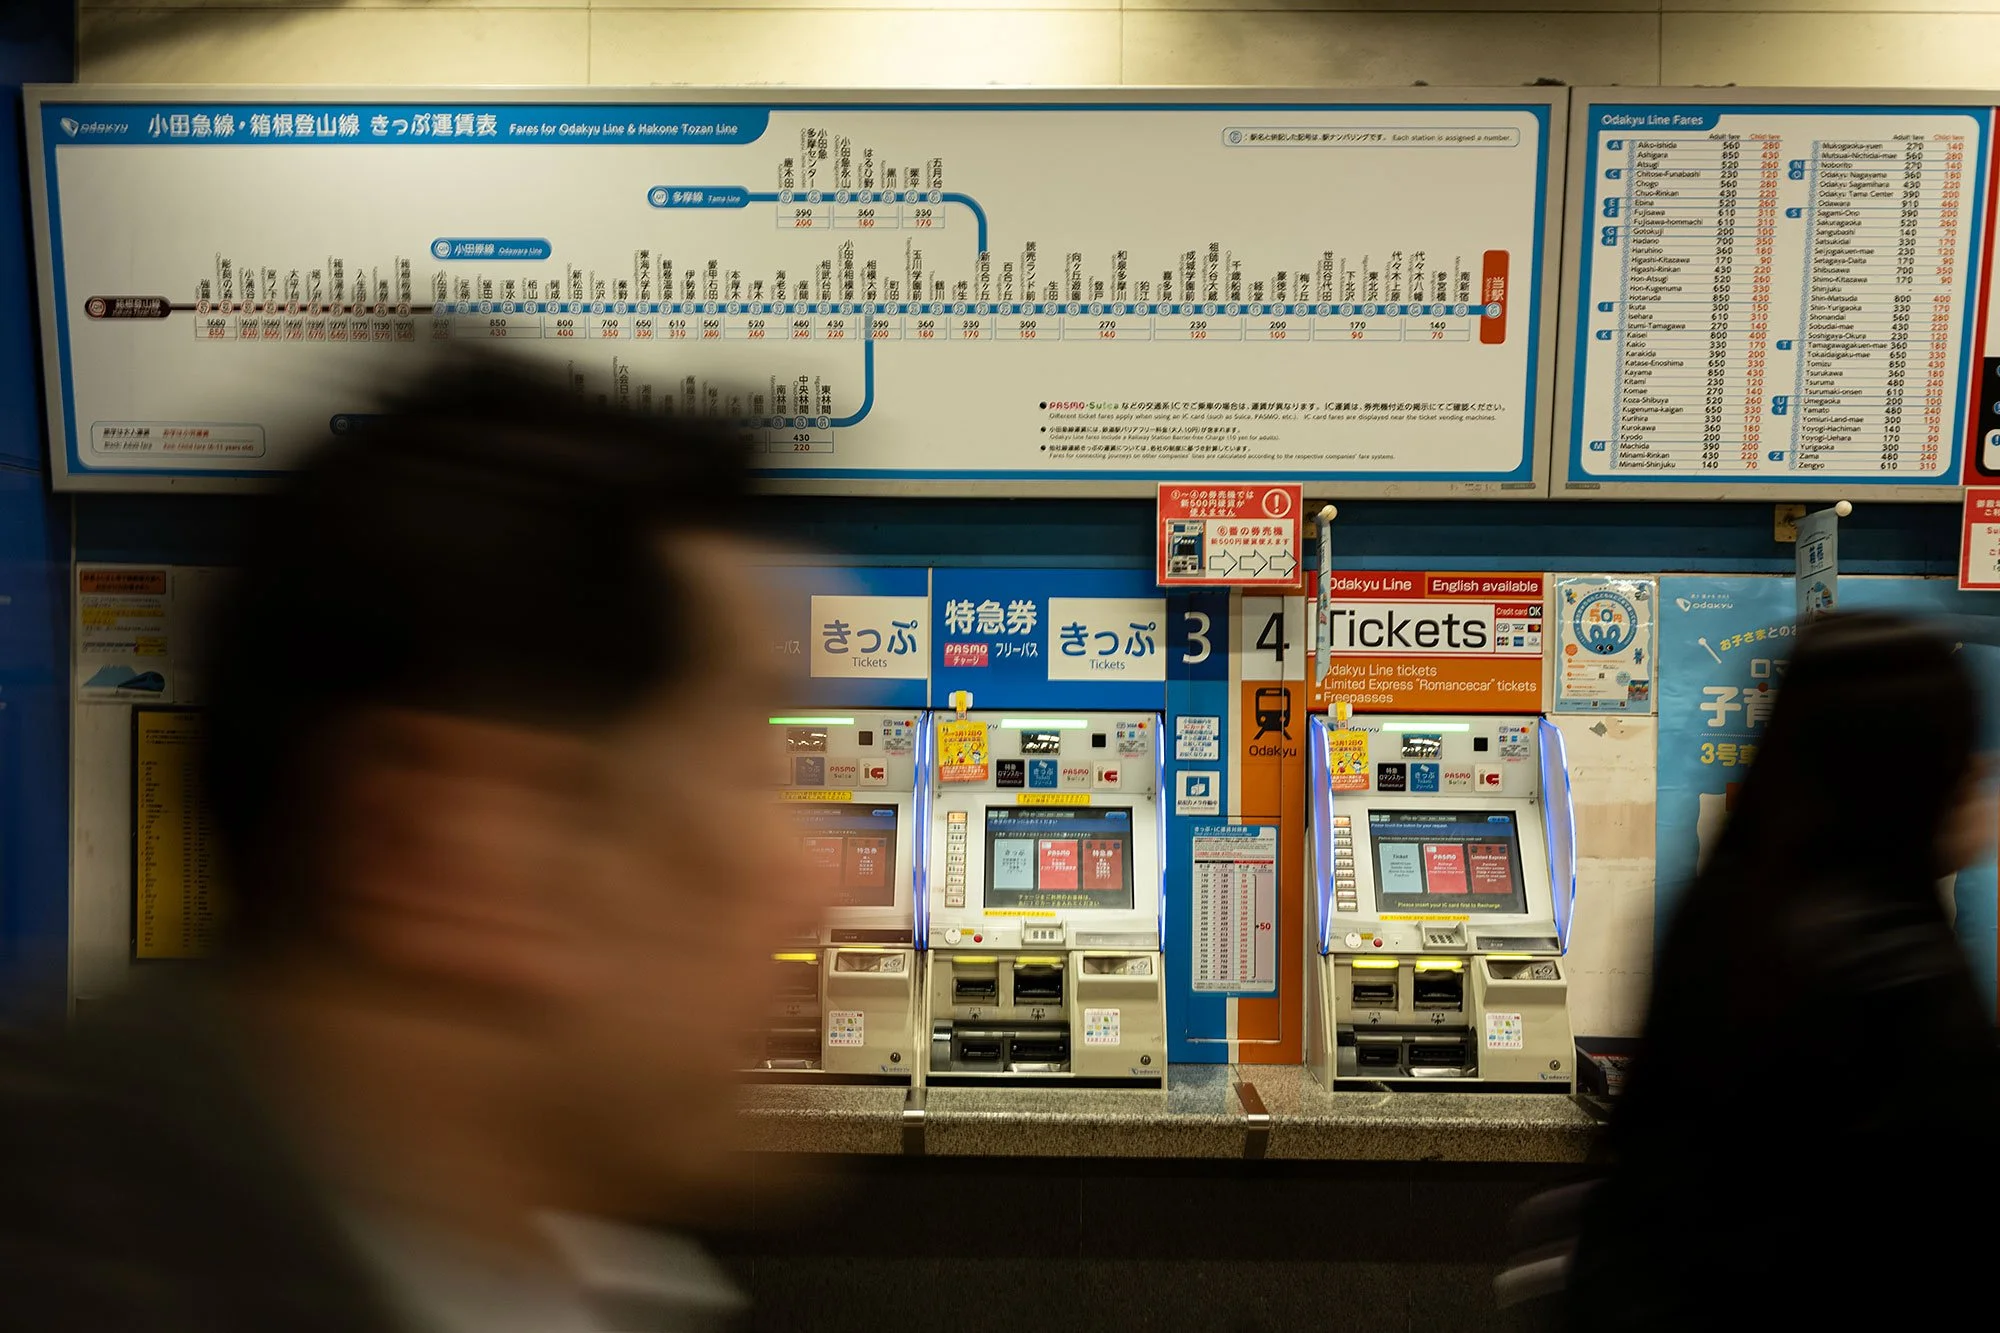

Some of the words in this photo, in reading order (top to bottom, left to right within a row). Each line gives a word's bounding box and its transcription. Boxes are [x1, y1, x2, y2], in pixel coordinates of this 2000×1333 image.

[370, 113, 497, 137] きっぷ運賃表
[1602, 115, 1644, 127] Odakyu
[1648, 115, 1670, 124] Line
[1673, 115, 1703, 125] Fares
[509, 124, 538, 135] Fares
[541, 124, 556, 135] for
[559, 123, 600, 138] Odakyu
[603, 124, 624, 134] Line
[628, 124, 636, 134] &
[639, 124, 678, 134] Hakone
[682, 124, 713, 134] Tozan
[716, 124, 738, 134] Line
[864, 148, 873, 188] はるひ野
[889, 280, 899, 300] 町田
[776, 384, 786, 415] 南林間
[799, 375, 809, 415] 中央林間
[822, 385, 831, 415] 東林間
[1383, 578, 1412, 590] Line
[1433, 580, 1479, 593] English
[1482, 581, 1538, 592] available
[1528, 606, 1542, 617] OK
[1692, 601, 1733, 609] odakyu
[945, 599, 1038, 635] 特急券
[822, 619, 918, 654] きっぷ
[1060, 621, 1156, 656] きっぷ
[1182, 612, 1211, 664] 3
[1256, 612, 1290, 662] 4
[945, 645, 987, 656] PASMO
[852, 657, 887, 668] Tickets
[953, 656, 980, 666] チャージ
[1089, 659, 1125, 670] Tickets
[1370, 665, 1393, 676] Line
[1397, 665, 1437, 676] tickets
[1324, 679, 1367, 689] Limited
[1369, 680, 1413, 691] Express
[1497, 681, 1537, 691] tickets
[1324, 693, 1393, 703] Freepasses
[1249, 745, 1297, 757] Odakyu
